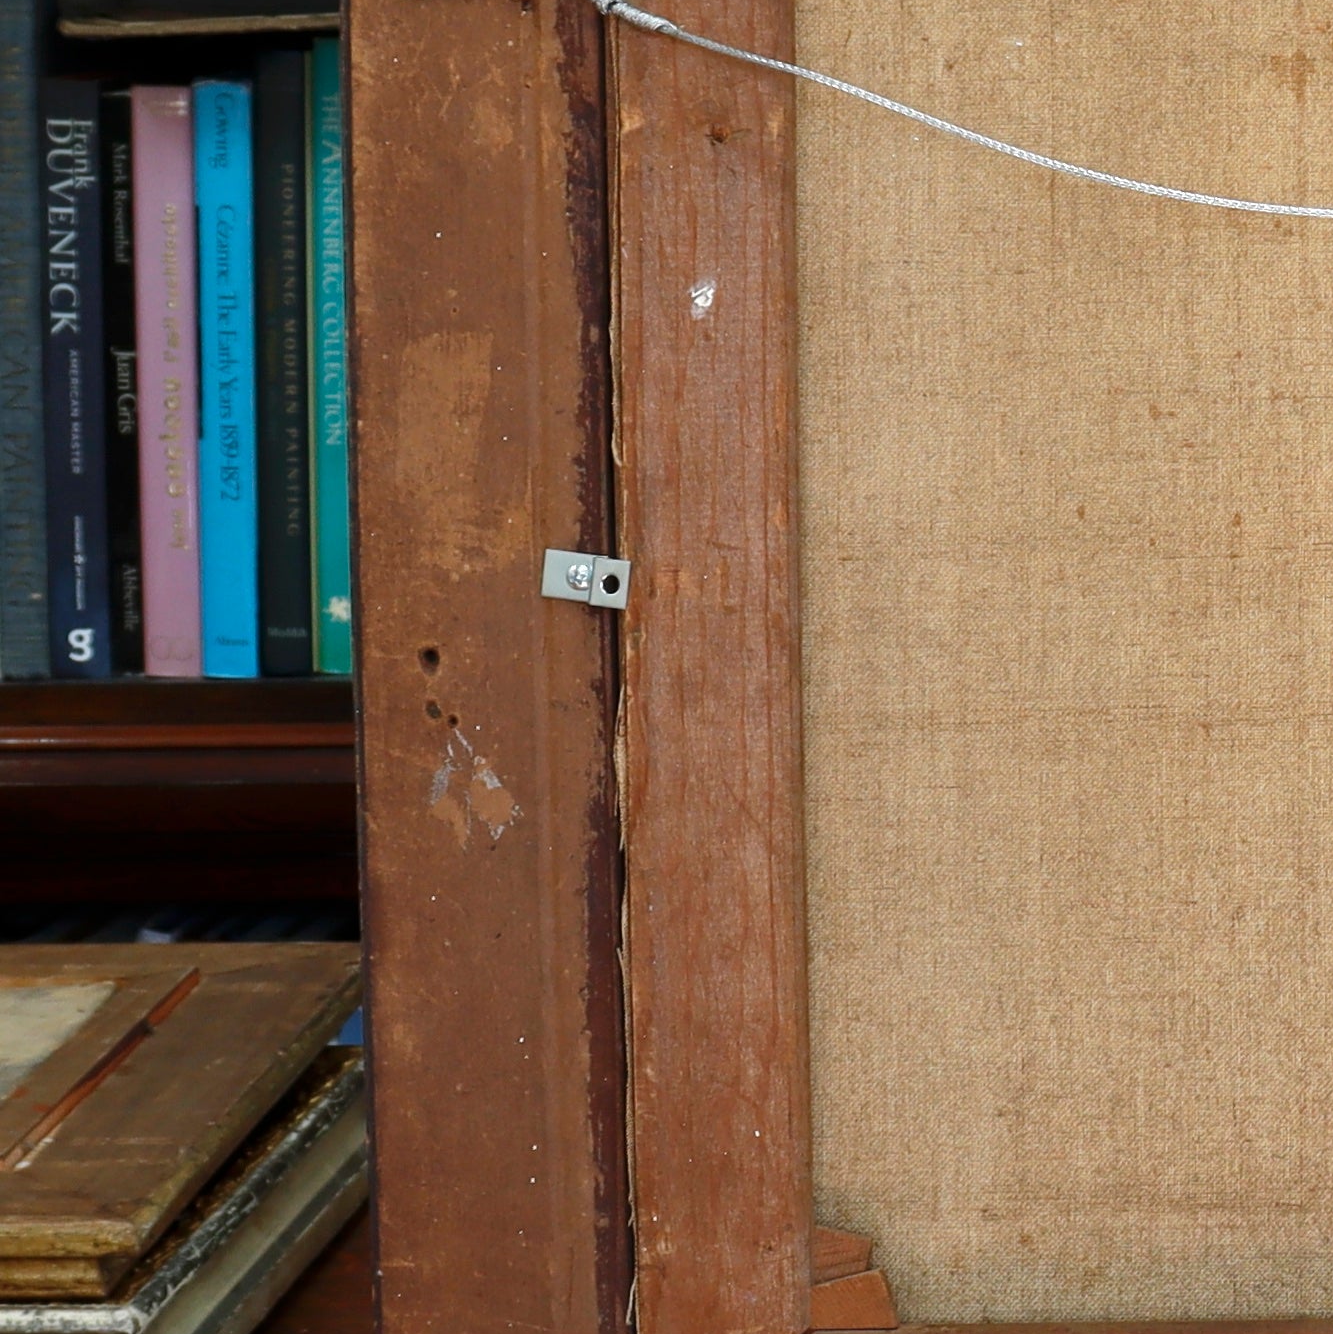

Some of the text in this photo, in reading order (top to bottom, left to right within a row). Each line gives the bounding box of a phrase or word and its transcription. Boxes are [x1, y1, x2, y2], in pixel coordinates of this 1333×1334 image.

[73, 118, 96, 190] Frank
[207, 91, 234, 169] Gowing
[111, 142, 131, 264] Mark Rosenthal
[45, 116, 83, 476] DUVENECK AMERICAN MASTER
[320, 93, 345, 447] THE ANNENBERG COLLECTION
[110, 346, 137, 436] Juan Gris
[213, 292, 240, 421] The Early Years
[280, 162, 302, 538] PIONEERING MODERN PAINTING
[3, 432, 43, 610] PAINTING
[120, 562, 139, 632] Abbeville
